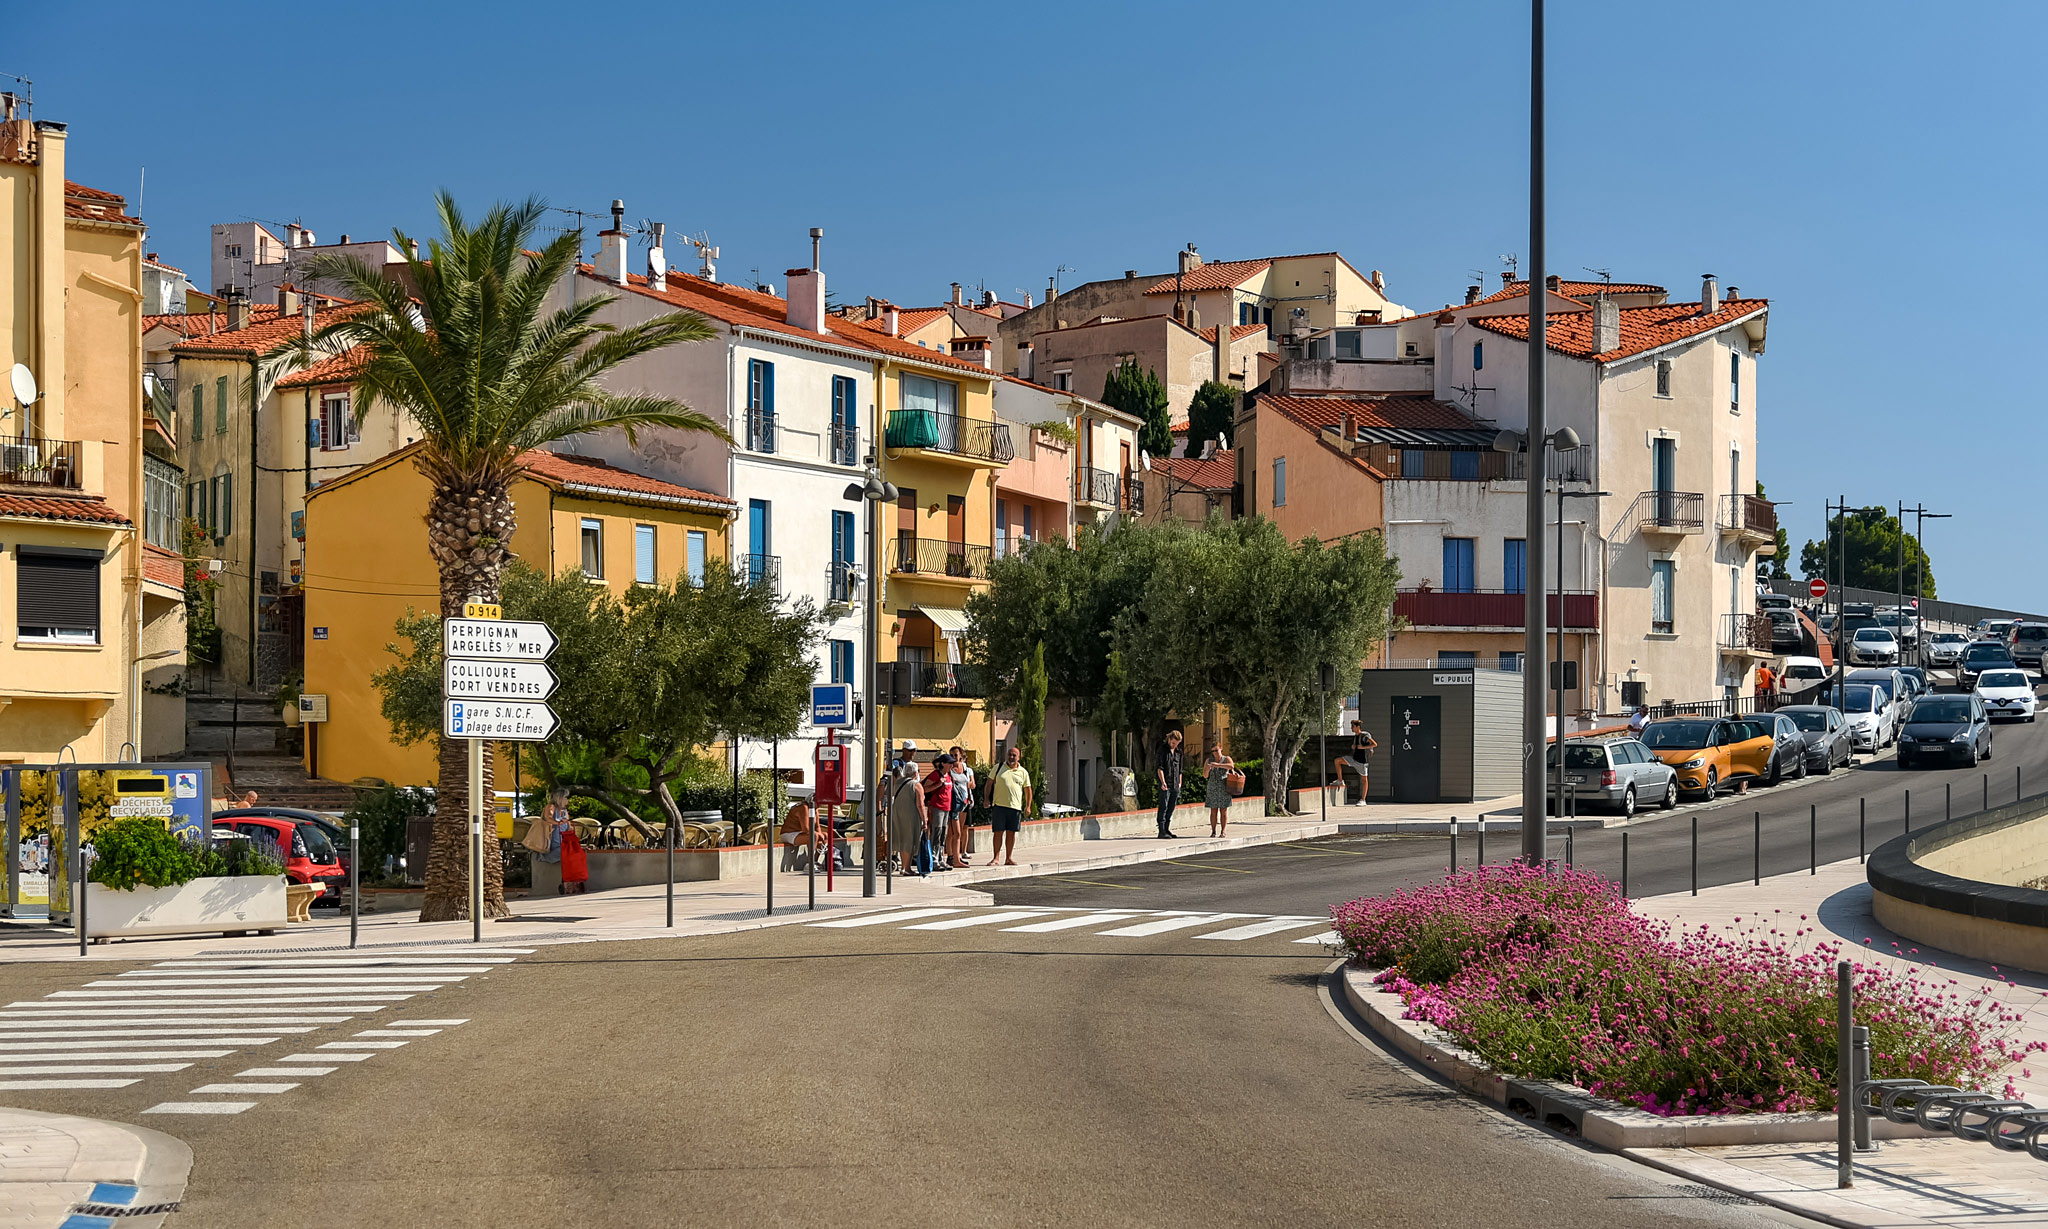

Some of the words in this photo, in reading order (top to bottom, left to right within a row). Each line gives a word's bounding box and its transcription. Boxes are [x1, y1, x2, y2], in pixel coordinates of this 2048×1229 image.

[468, 606, 475, 616] D
[478, 606, 497, 618] 914
[451, 625, 518, 639] PERPIGNAN
[452, 639, 502, 652] ARGELÈS
[518, 643, 542, 654] MER
[452, 665, 517, 679] COLLIOURE
[452, 680, 481, 692] PORT
[487, 682, 540, 694] VENDRES
[454, 706, 462, 716] P
[466, 708, 490, 720] gare
[495, 707, 534, 719] S.N.C.F.
[454, 720, 462, 731] P
[466, 721, 492, 734] plage
[496, 722, 512, 733] des
[516, 722, 543, 734] Elmes
[122, 797, 162, 807] DÉCHETS
[112, 806, 172, 816] RECYCLABLES
